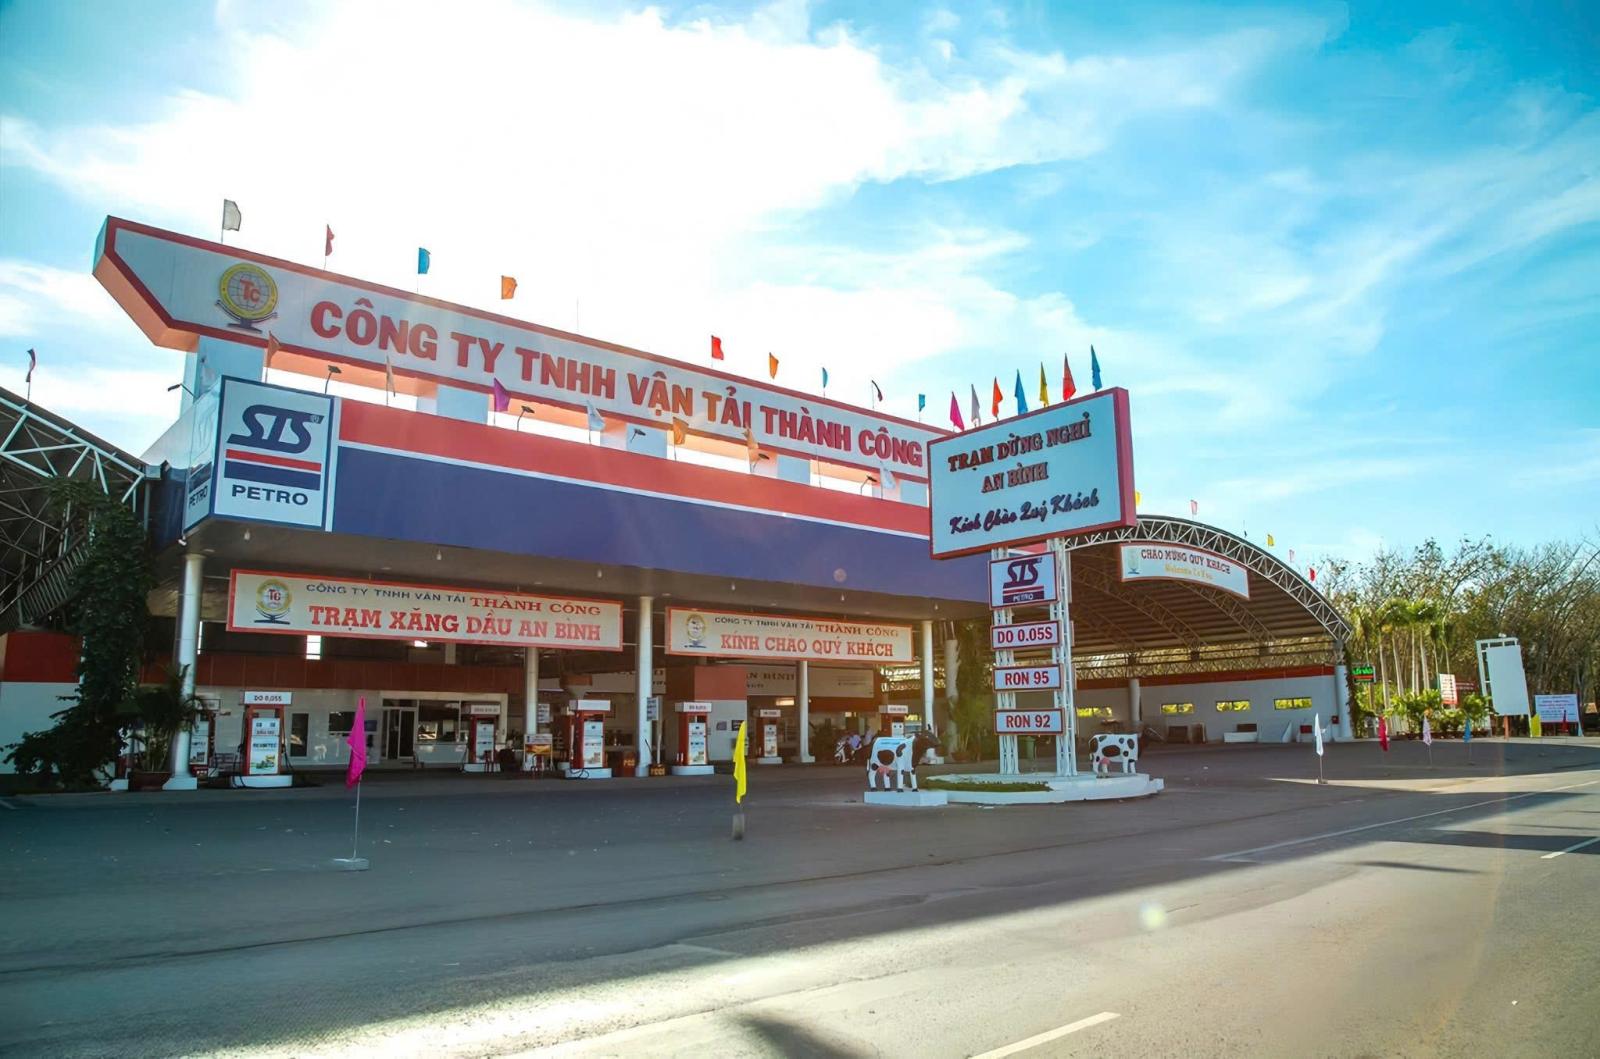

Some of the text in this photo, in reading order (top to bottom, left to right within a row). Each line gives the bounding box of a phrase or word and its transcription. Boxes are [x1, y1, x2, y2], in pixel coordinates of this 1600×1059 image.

[310, 297, 923, 467] CÔNG TY TNHH VẬN TẢI THÀNH CÔNG
[226, 404, 322, 454] STS
[948, 412, 1092, 472] TRẠM DỪNG NGHỈ
[981, 462, 1049, 494] AN BÌNH
[232, 485, 308, 505] PETRO
[306, 583, 347, 594] CÔNG
[351, 587, 368, 595] TY
[374, 588, 410, 598] TNHH
[470, 596, 542, 611] THÀNH
[550, 602, 601, 616] CÔNG
[309, 605, 601, 640] TRẠM XĂNG DẦU AN BÌNH
[756, 619, 778, 627] TNHH
[815, 622, 861, 635] THÀNH
[866, 626, 898, 637] CÔNG
[997, 626, 1053, 644] DO 0.05S
[721, 630, 893, 657] KÍNH CHÀO QUÝ KHÁCH
[1005, 671, 1049, 685] RON 95
[1006, 715, 1050, 728] RON 92
